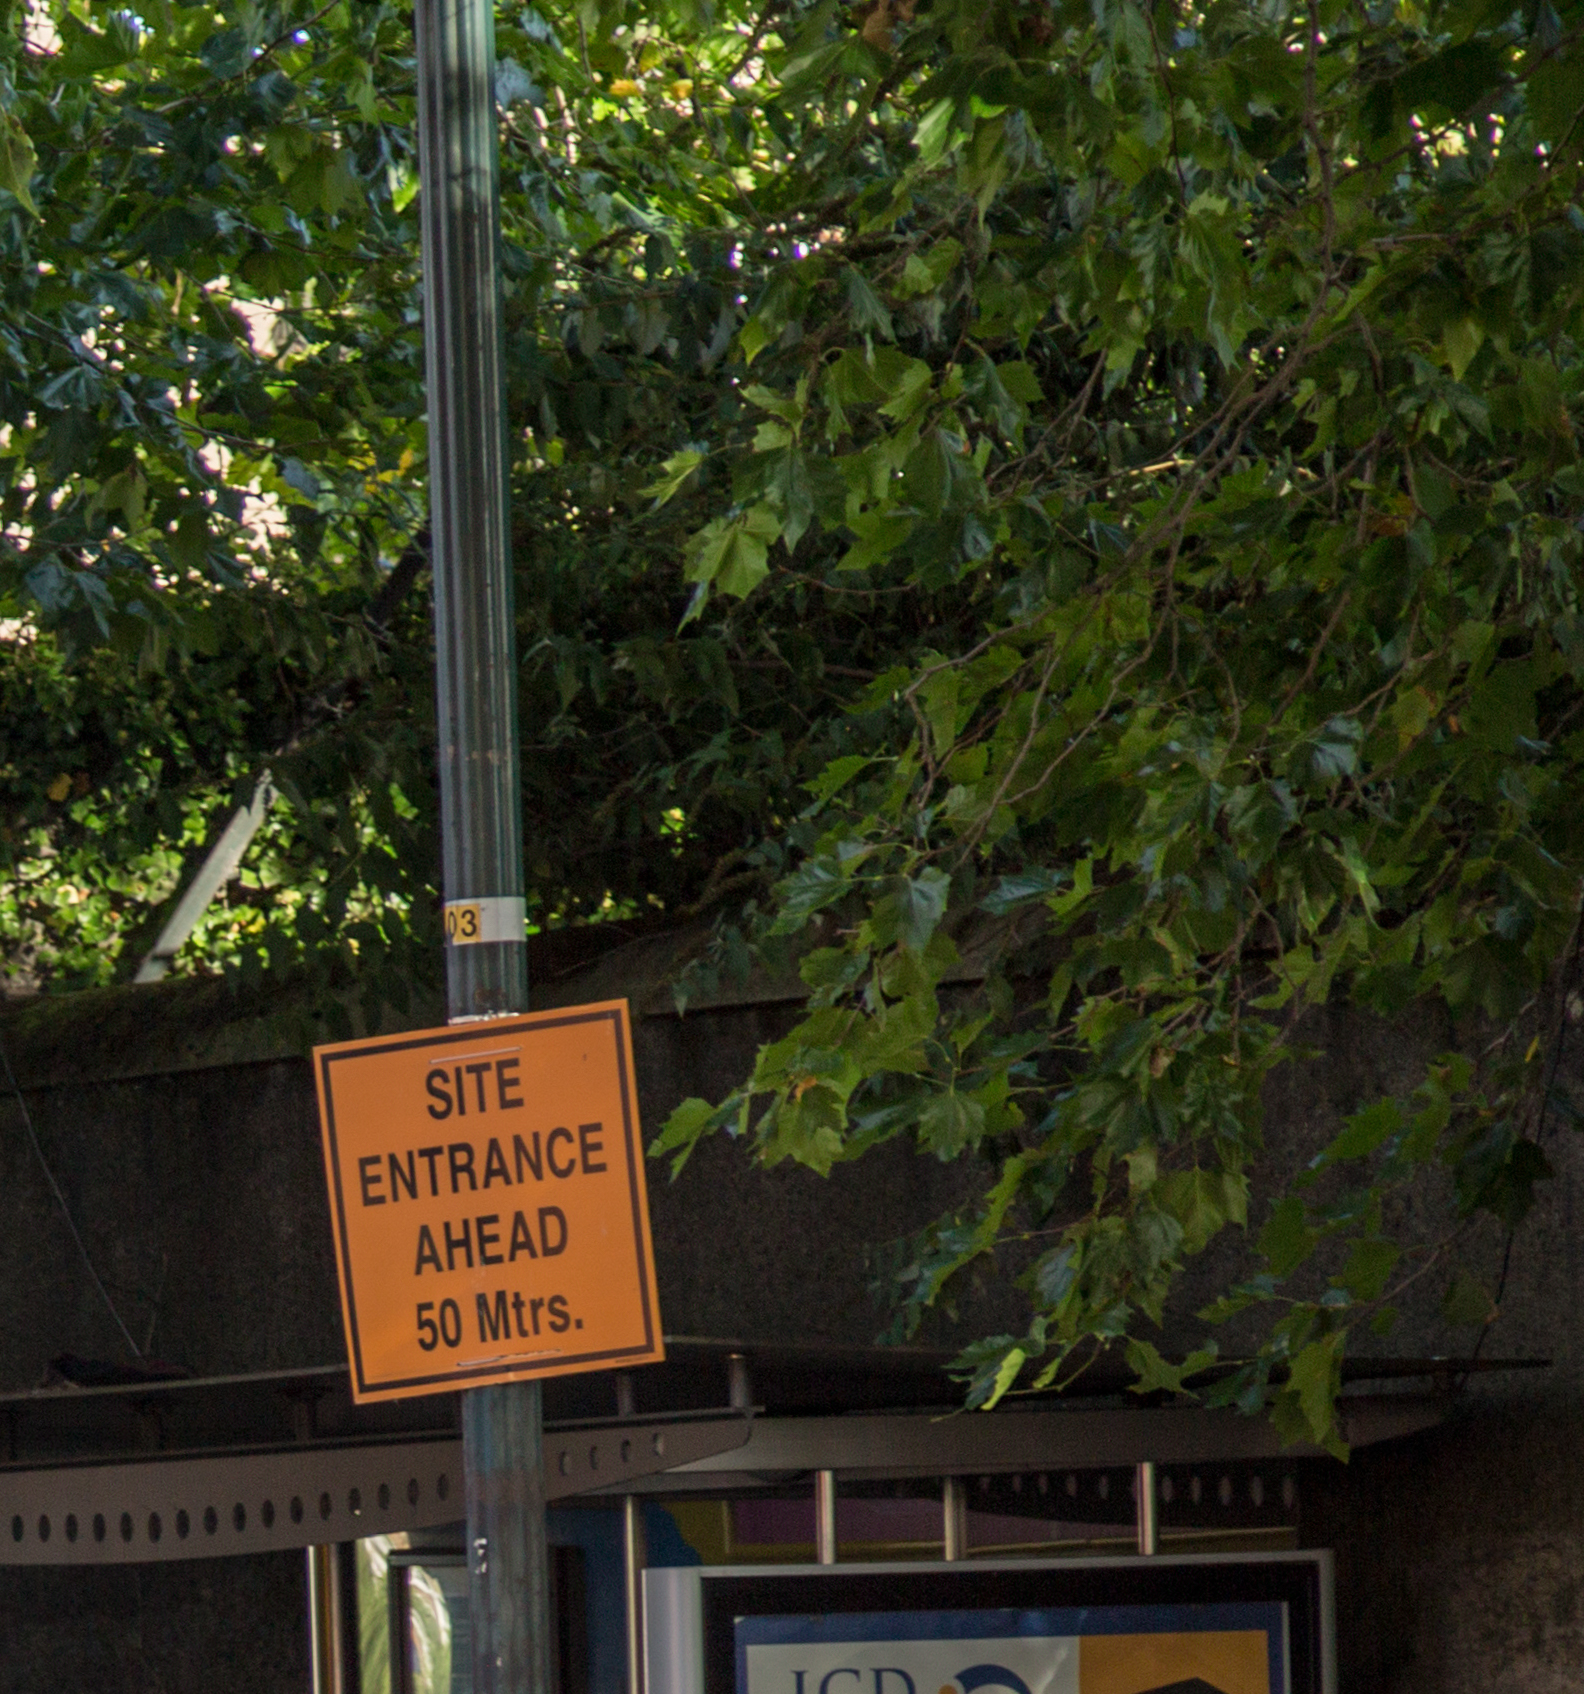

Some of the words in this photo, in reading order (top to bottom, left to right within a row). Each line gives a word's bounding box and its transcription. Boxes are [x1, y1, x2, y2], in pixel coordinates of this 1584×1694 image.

[426, 1057, 525, 1120] SITE
[358, 1122, 608, 1207] ENTRANCE
[414, 1205, 568, 1276] AHEAD
[416, 1298, 462, 1351] 50
[477, 1289, 584, 1344] Mtrs.
